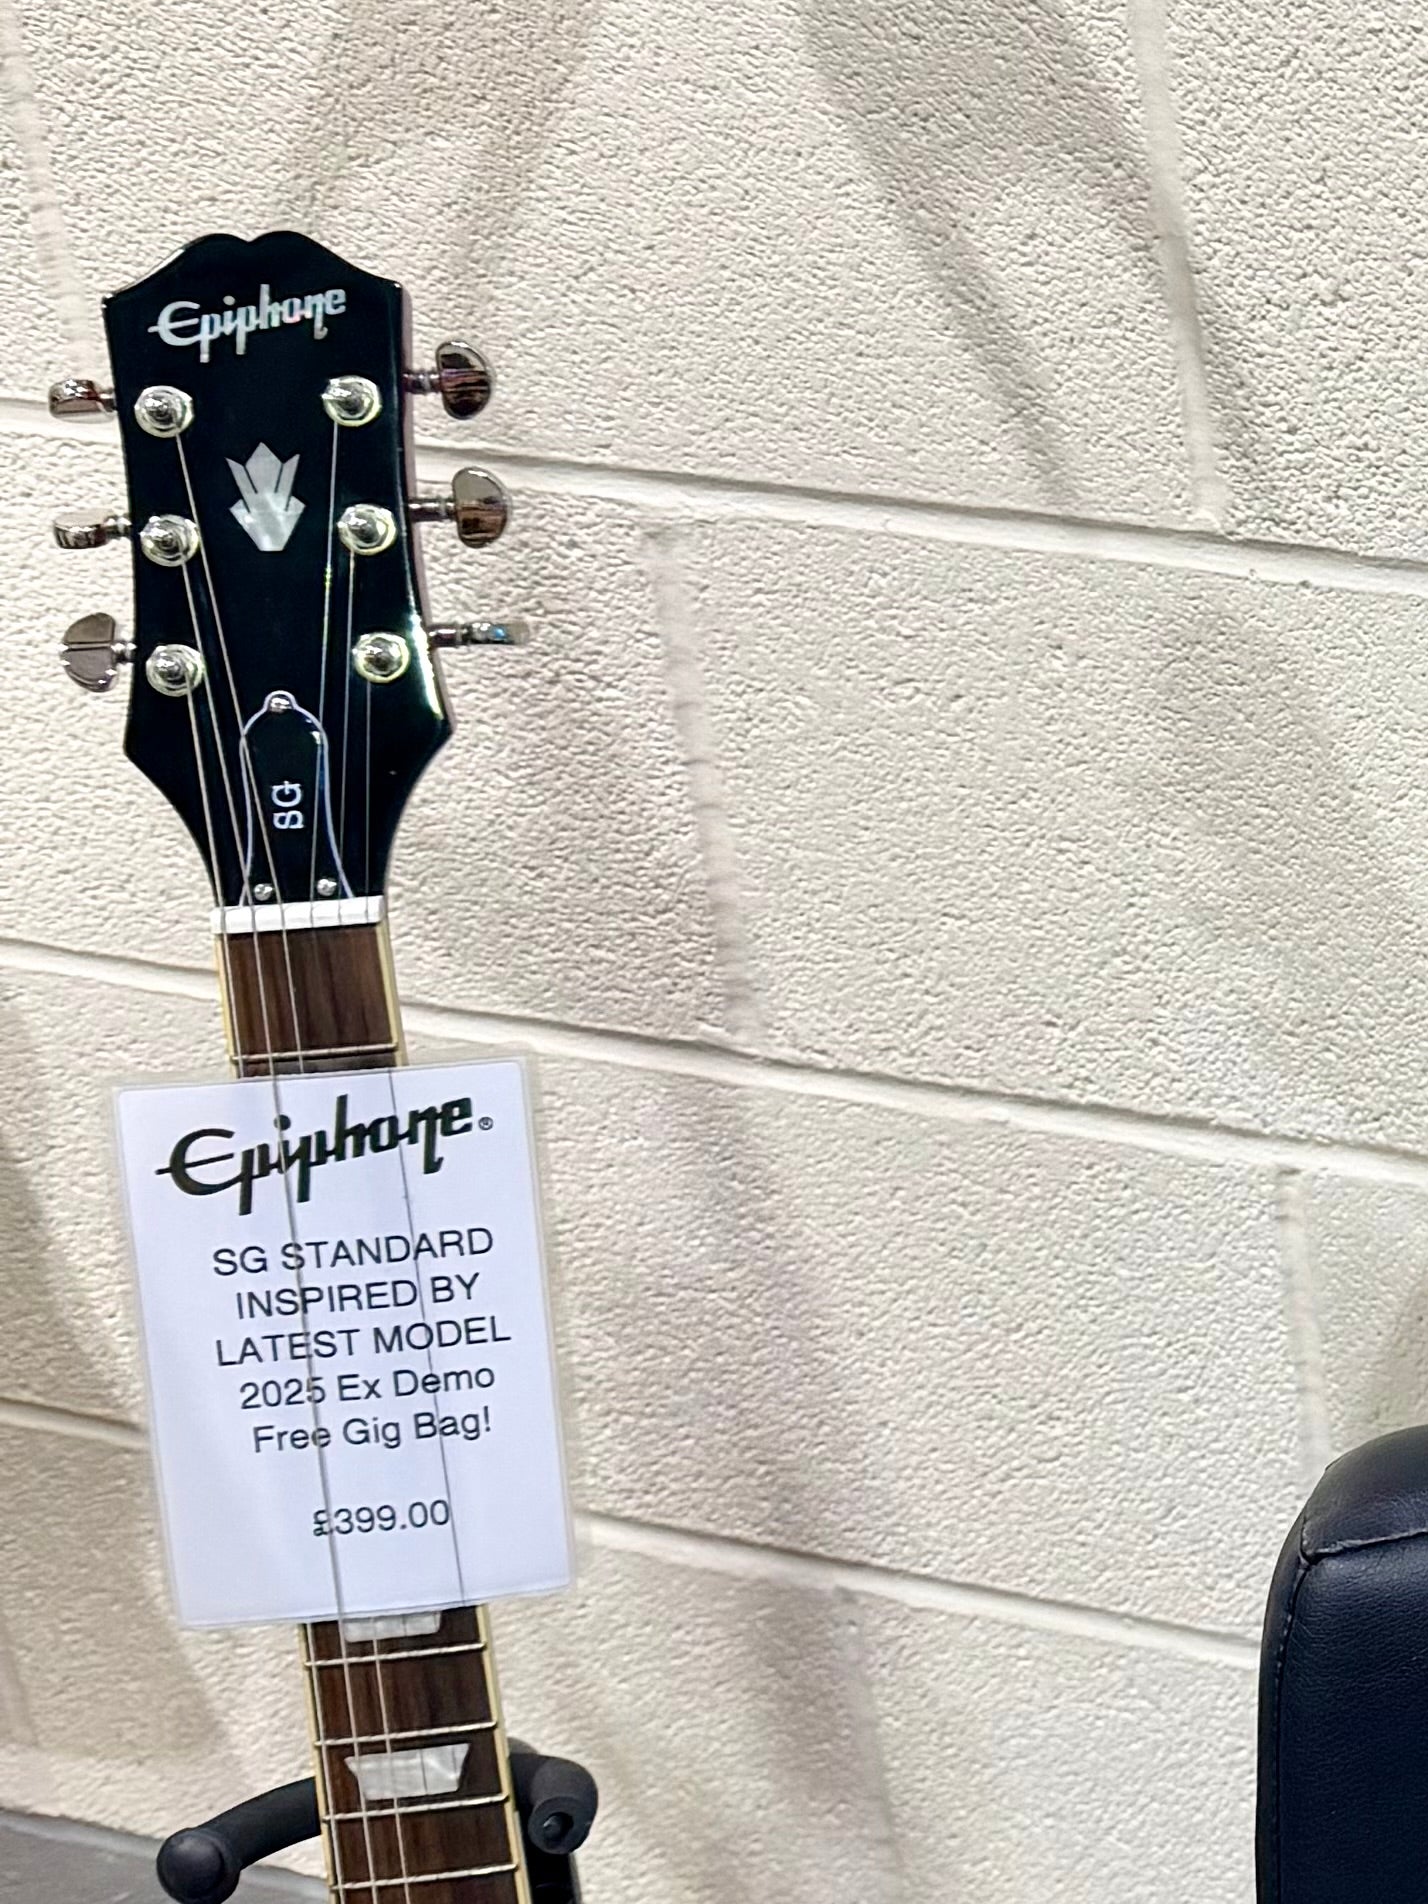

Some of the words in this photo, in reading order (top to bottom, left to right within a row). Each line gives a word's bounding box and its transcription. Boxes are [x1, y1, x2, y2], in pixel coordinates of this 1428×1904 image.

[147, 283, 347, 364] Epiphone
[271, 780, 304, 830] SG
[155, 1093, 474, 1216] Epiphone
[213, 1248, 268, 1276] SG
[281, 1227, 494, 1271] STANDARD
[236, 1279, 418, 1320] INSPIRED
[430, 1272, 481, 1304] BY
[215, 1328, 361, 1367] LATEST
[373, 1315, 512, 1354] MODEL
[240, 1376, 327, 1410] 2025
[336, 1373, 383, 1402] Ex
[392, 1366, 495, 1398] Demo
[253, 1424, 332, 1454] Free
[342, 1417, 401, 1449] Gig
[414, 1405, 492, 1441] Bag!
[312, 1498, 451, 1537] £399.00
